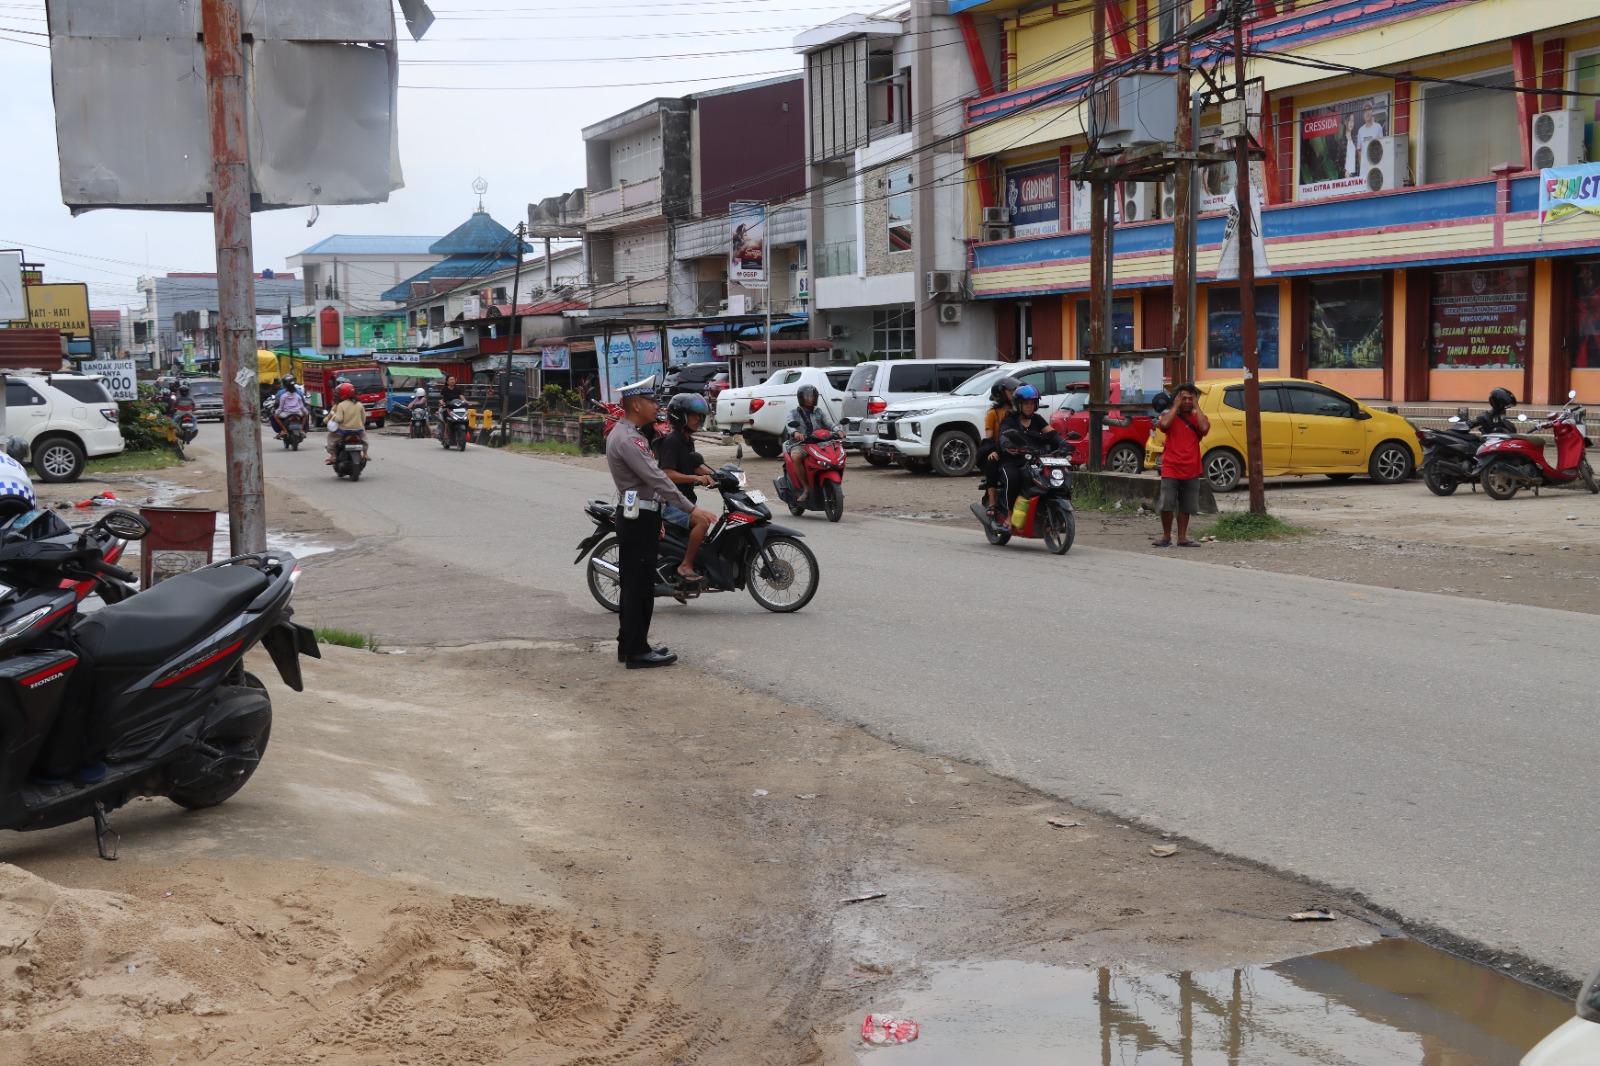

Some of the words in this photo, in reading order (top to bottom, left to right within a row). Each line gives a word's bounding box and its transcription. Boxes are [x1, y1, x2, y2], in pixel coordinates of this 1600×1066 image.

[1304, 119, 1338, 132] CRESSIDA
[1022, 177, 1053, 201] CARDINAL
[1313, 182, 1331, 192] CITRA
[1332, 179, 1363, 189] SWALAYAN
[1447, 346, 1469, 356] TAHUN
[1471, 346, 1490, 355] BARU
[83, 363, 112, 371] LANDAK
[771, 360, 803, 368] KELUAR
[30, 672, 64, 689] HONDA
